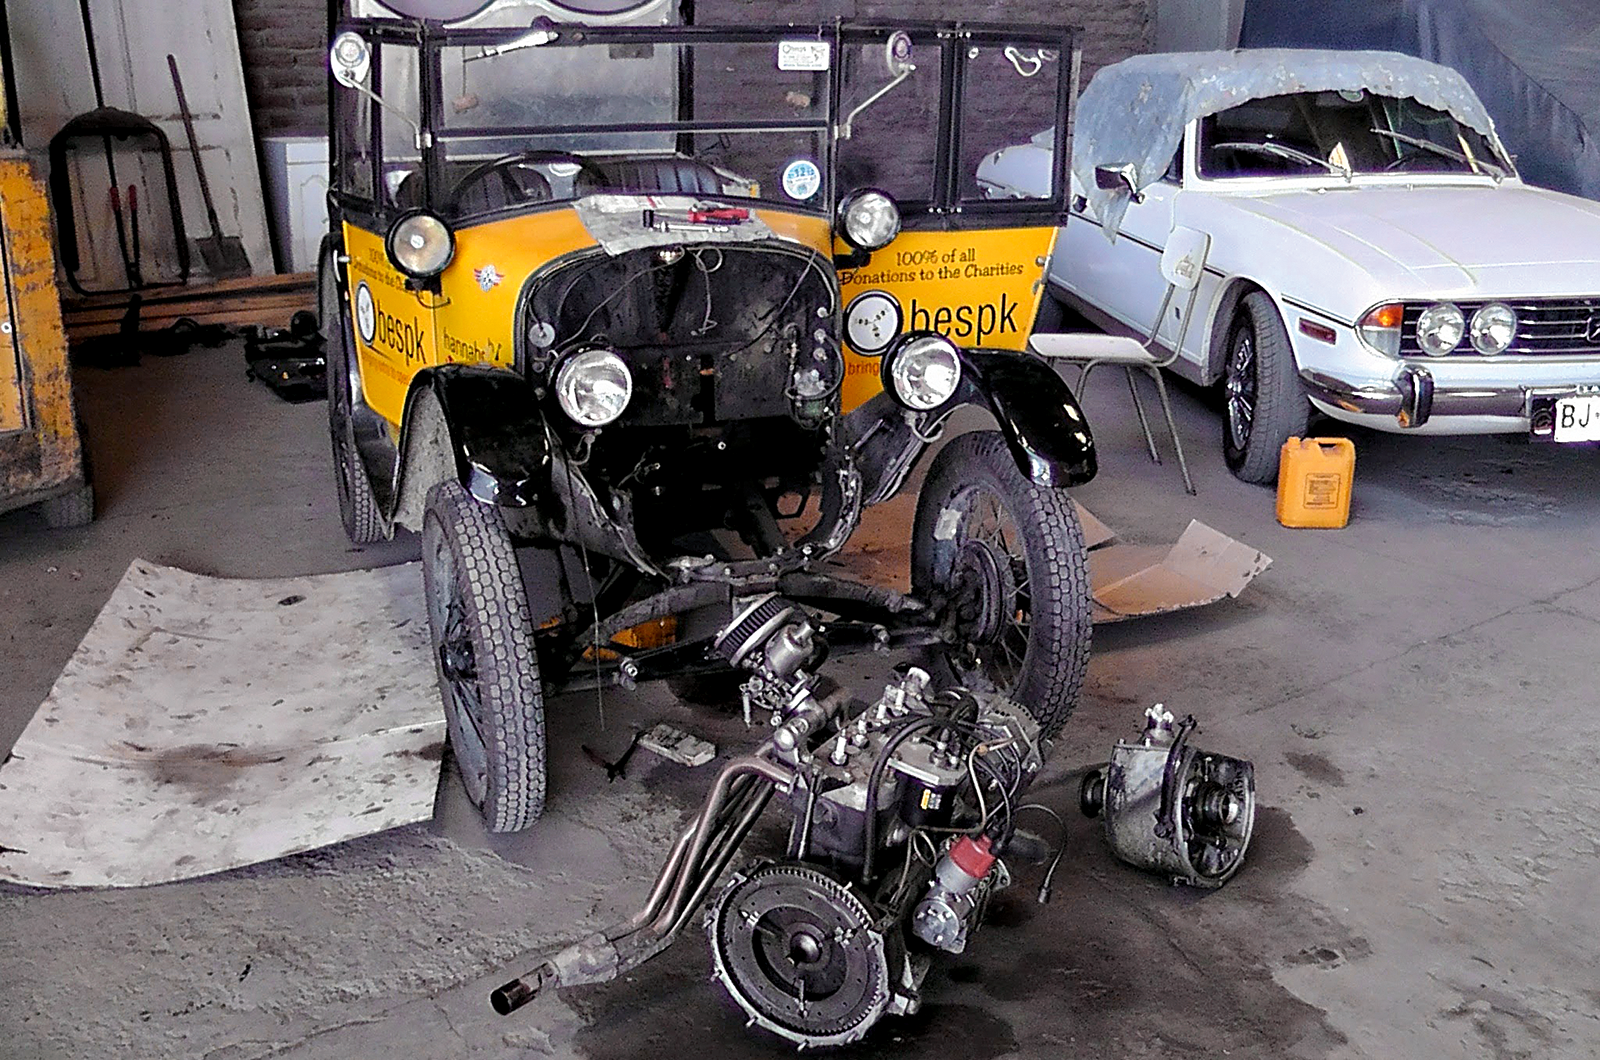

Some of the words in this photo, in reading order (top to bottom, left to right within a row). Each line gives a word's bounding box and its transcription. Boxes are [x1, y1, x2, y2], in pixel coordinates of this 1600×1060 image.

[840, 269, 916, 286] Donations
[919, 269, 934, 281] to
[938, 266, 960, 279] the
[964, 262, 1024, 278] Charities
[897, 250, 938, 266] 100%
[941, 248, 957, 263] of
[959, 248, 975, 262] all
[376, 299, 427, 367] bespk
[911, 293, 1019, 346] bespk
